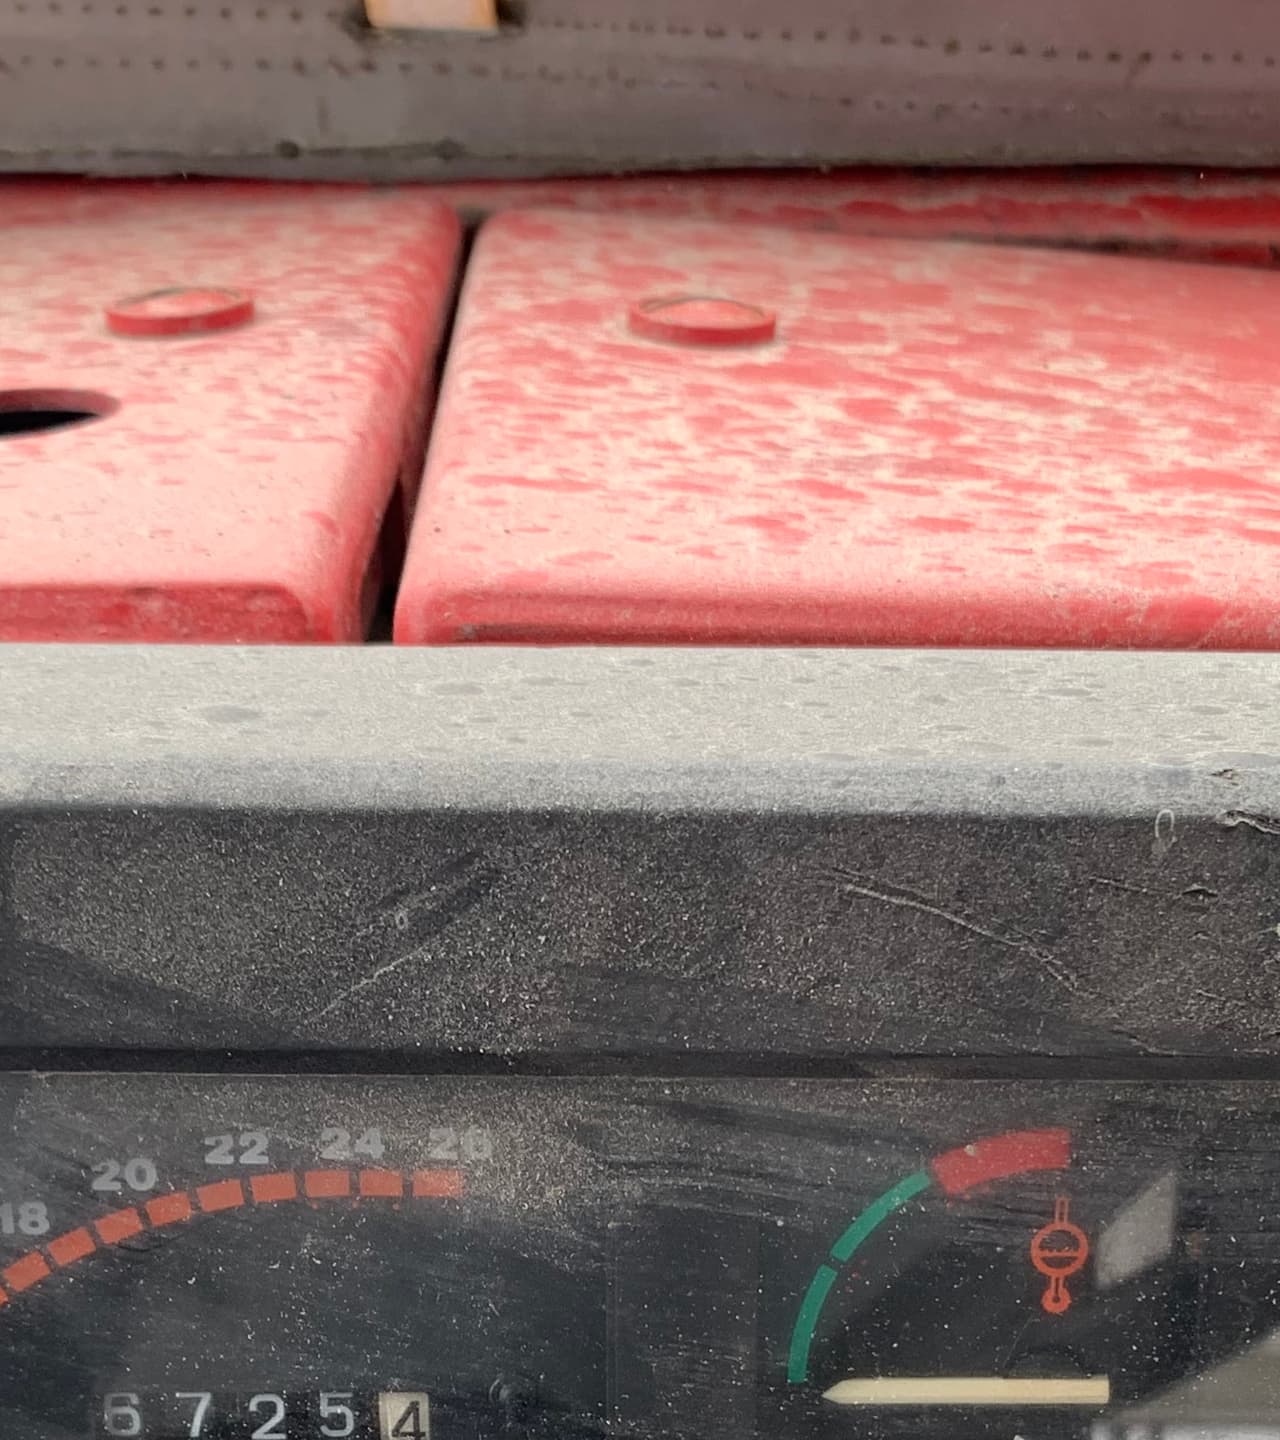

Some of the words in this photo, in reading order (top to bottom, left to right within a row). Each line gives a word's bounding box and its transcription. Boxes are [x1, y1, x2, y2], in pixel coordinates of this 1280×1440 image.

[92, 1158, 157, 1191] 20
[205, 1132, 269, 1164] 22
[320, 1127, 385, 1160] 24
